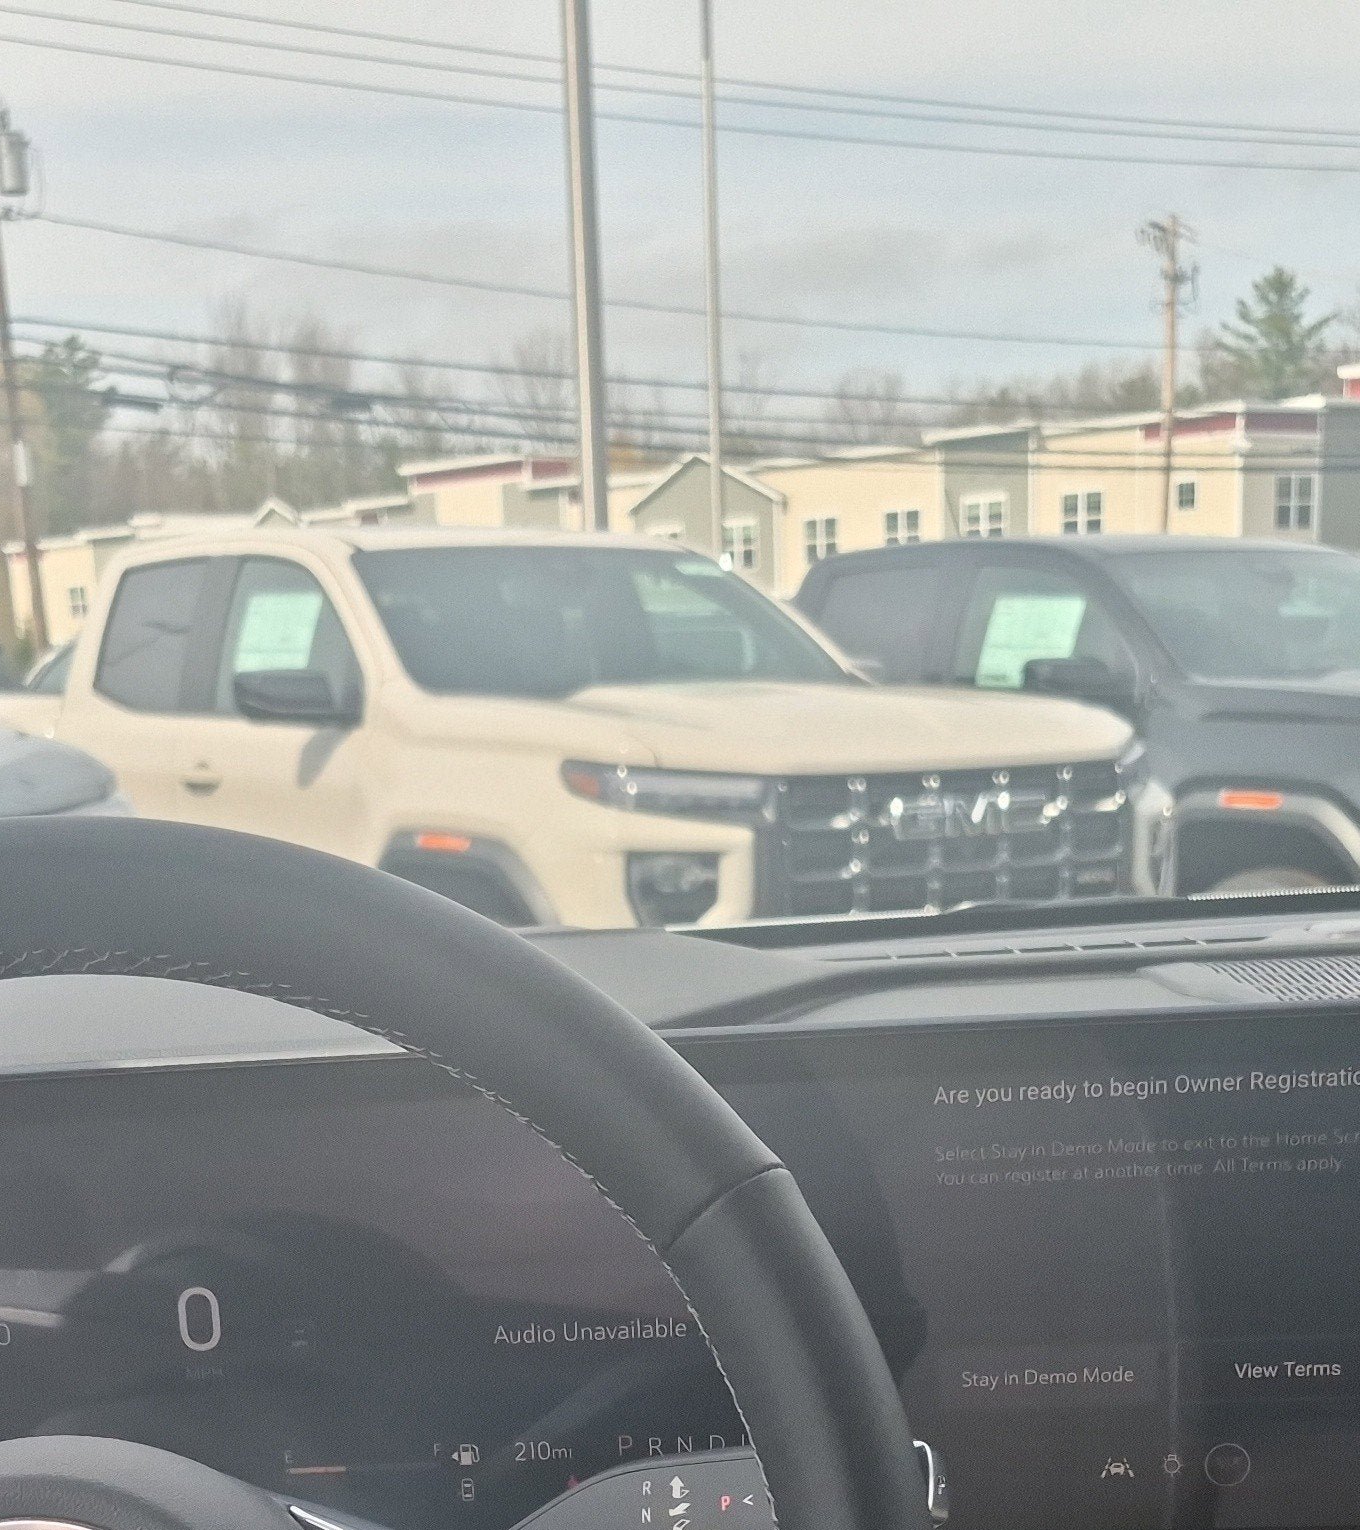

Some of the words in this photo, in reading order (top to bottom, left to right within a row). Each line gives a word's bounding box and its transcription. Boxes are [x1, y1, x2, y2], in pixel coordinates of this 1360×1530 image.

[934, 1086, 970, 1105] Are
[975, 1089, 1012, 1108] you
[1019, 1082, 1076, 1104] ready
[1083, 1082, 1103, 1098] to
[1109, 1076, 1168, 1100] begin
[1174, 1074, 1242, 1094] Owner
[935, 1144, 986, 1163] Select
[990, 1142, 1027, 1163] Stay
[1031, 1144, 1046, 1157] in
[1051, 1139, 1102, 1157] Demo
[1107, 1137, 1156, 1155] Mode
[1161, 1137, 1179, 1152] to
[1183, 1135, 1215, 1153] exit
[1220, 1134, 1237, 1149] to
[1242, 1131, 1270, 1148] the
[1275, 1130, 1327, 1147] Home
[936, 1169, 965, 1186] You
[970, 1171, 999, 1185] can
[1005, 1166, 1067, 1186] register
[1072, 1166, 1089, 1180] at
[1094, 1162, 1160, 1179] another
[1213, 1158, 1235, 1173] All
[1241, 1157, 1292, 1173] Terms
[176, 1284, 222, 1353] 0
[493, 1320, 556, 1346] Audio
[562, 1315, 687, 1343] Unavailable
[962, 1370, 998, 1391] Stay
[1004, 1368, 1020, 1385] in
[1024, 1368, 1077, 1386] Demo
[1082, 1366, 1134, 1384] Mode
[1234, 1362, 1278, 1380] View
[1283, 1360, 1341, 1379] Terms
[514, 1440, 573, 1463] 210mi
[618, 1434, 634, 1457] P
[648, 1436, 663, 1456] R
[677, 1436, 693, 1453] N
[642, 1480, 652, 1496] R
[719, 1494, 732, 1511] P
[641, 1508, 652, 1524] N
